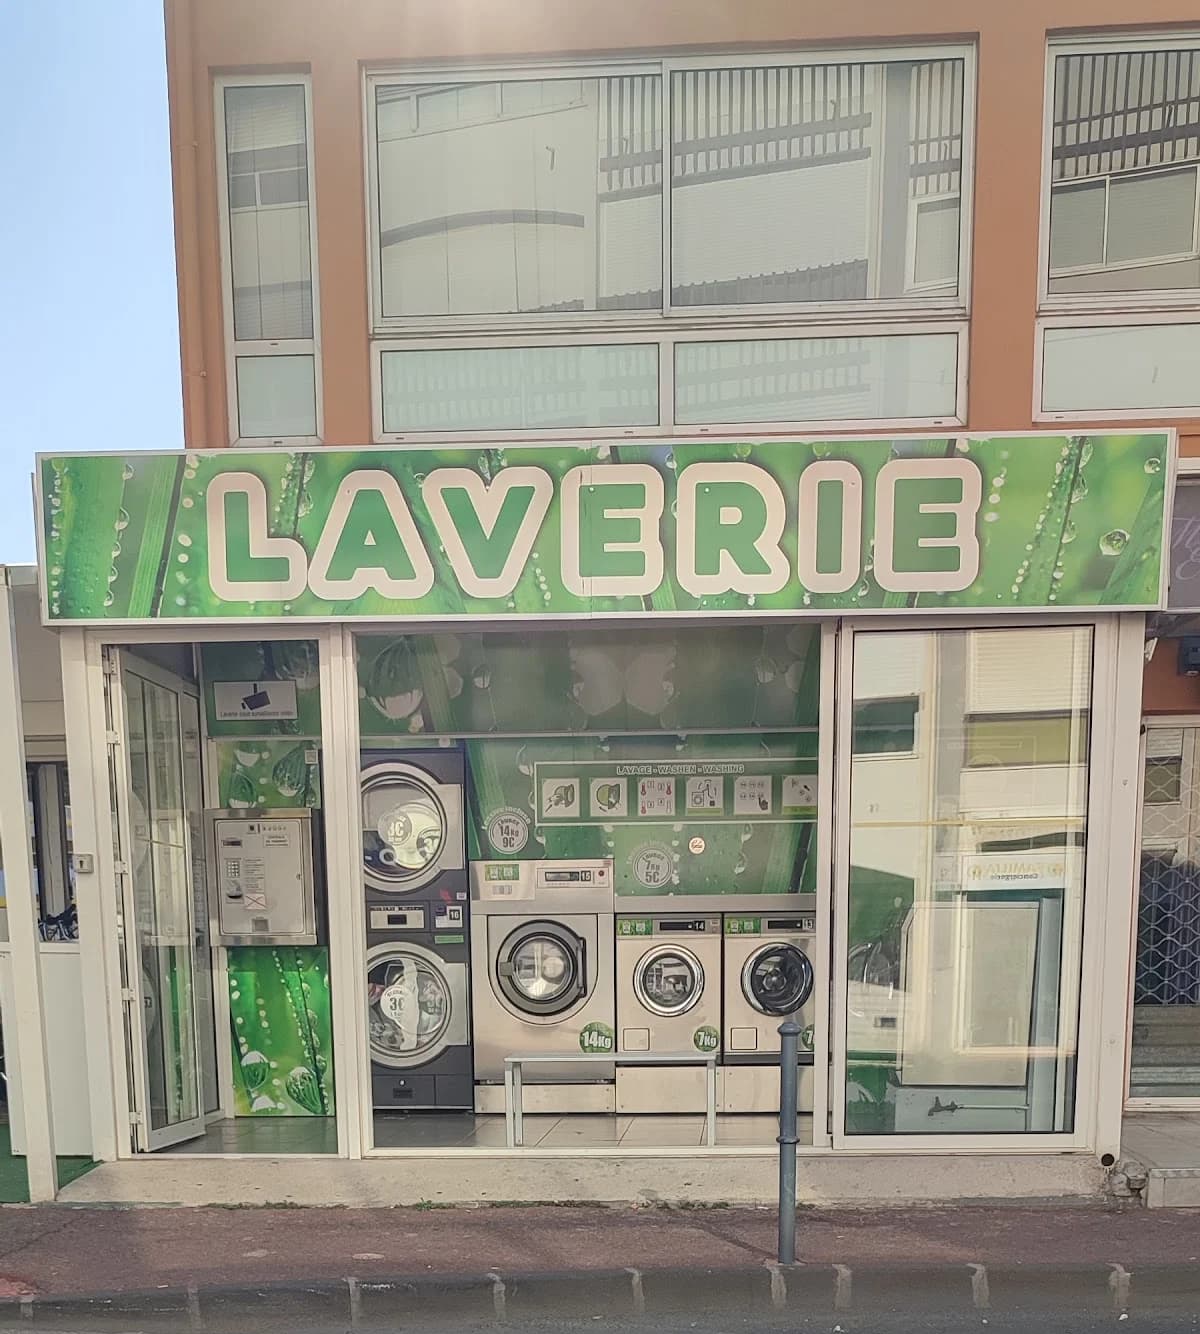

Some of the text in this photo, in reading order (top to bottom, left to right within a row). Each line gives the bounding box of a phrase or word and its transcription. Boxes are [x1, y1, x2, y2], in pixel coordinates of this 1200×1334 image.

[206, 457, 982, 602] LAVERIE
[616, 765, 652, 775] LAVAGE
[702, 764, 745, 774] WASHING
[582, 1030, 612, 1049] 14Kg
[697, 1031, 717, 1047] 7Kg
